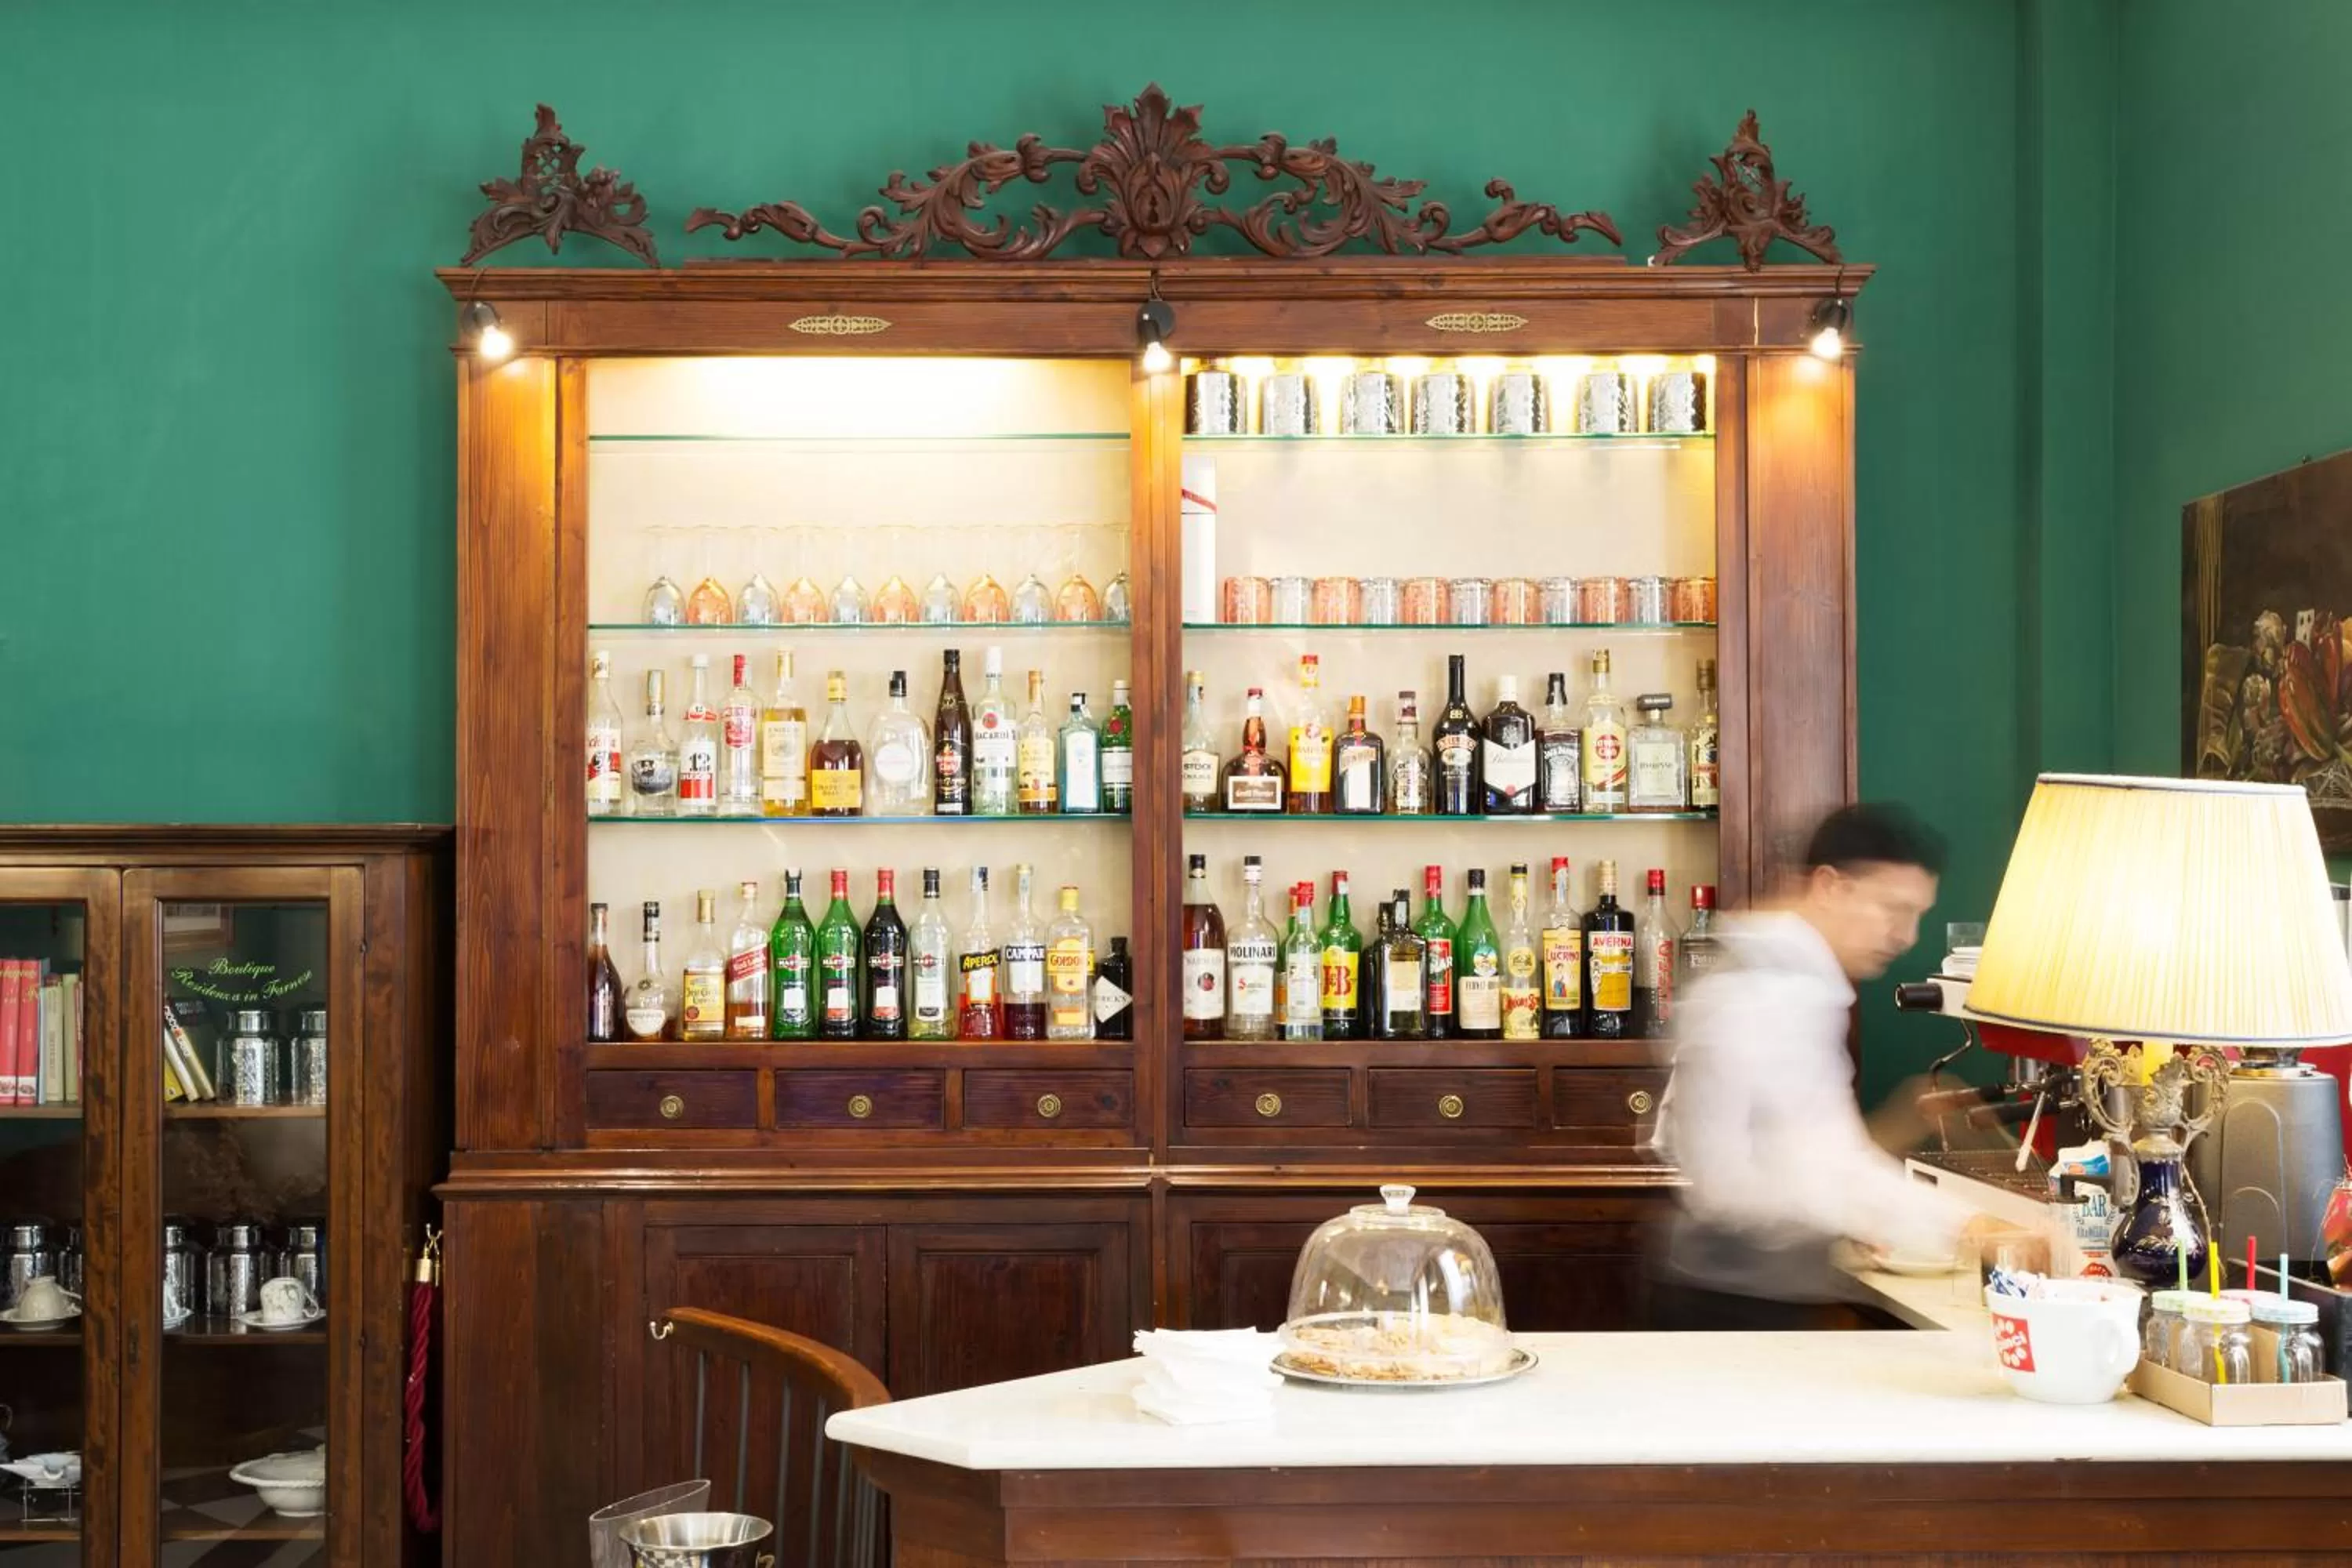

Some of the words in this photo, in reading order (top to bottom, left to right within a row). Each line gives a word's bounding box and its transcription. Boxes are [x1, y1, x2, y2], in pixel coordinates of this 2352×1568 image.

[1593, 937, 1632, 947] AVERNA
[1229, 946, 1276, 958] MOLINARI
[963, 953, 999, 969] APEROL
[1051, 954, 1093, 967] GORDOS
[208, 958, 276, 979] Boutique
[244, 991, 258, 1002] in
[2082, 1194, 2107, 1218] BAR
